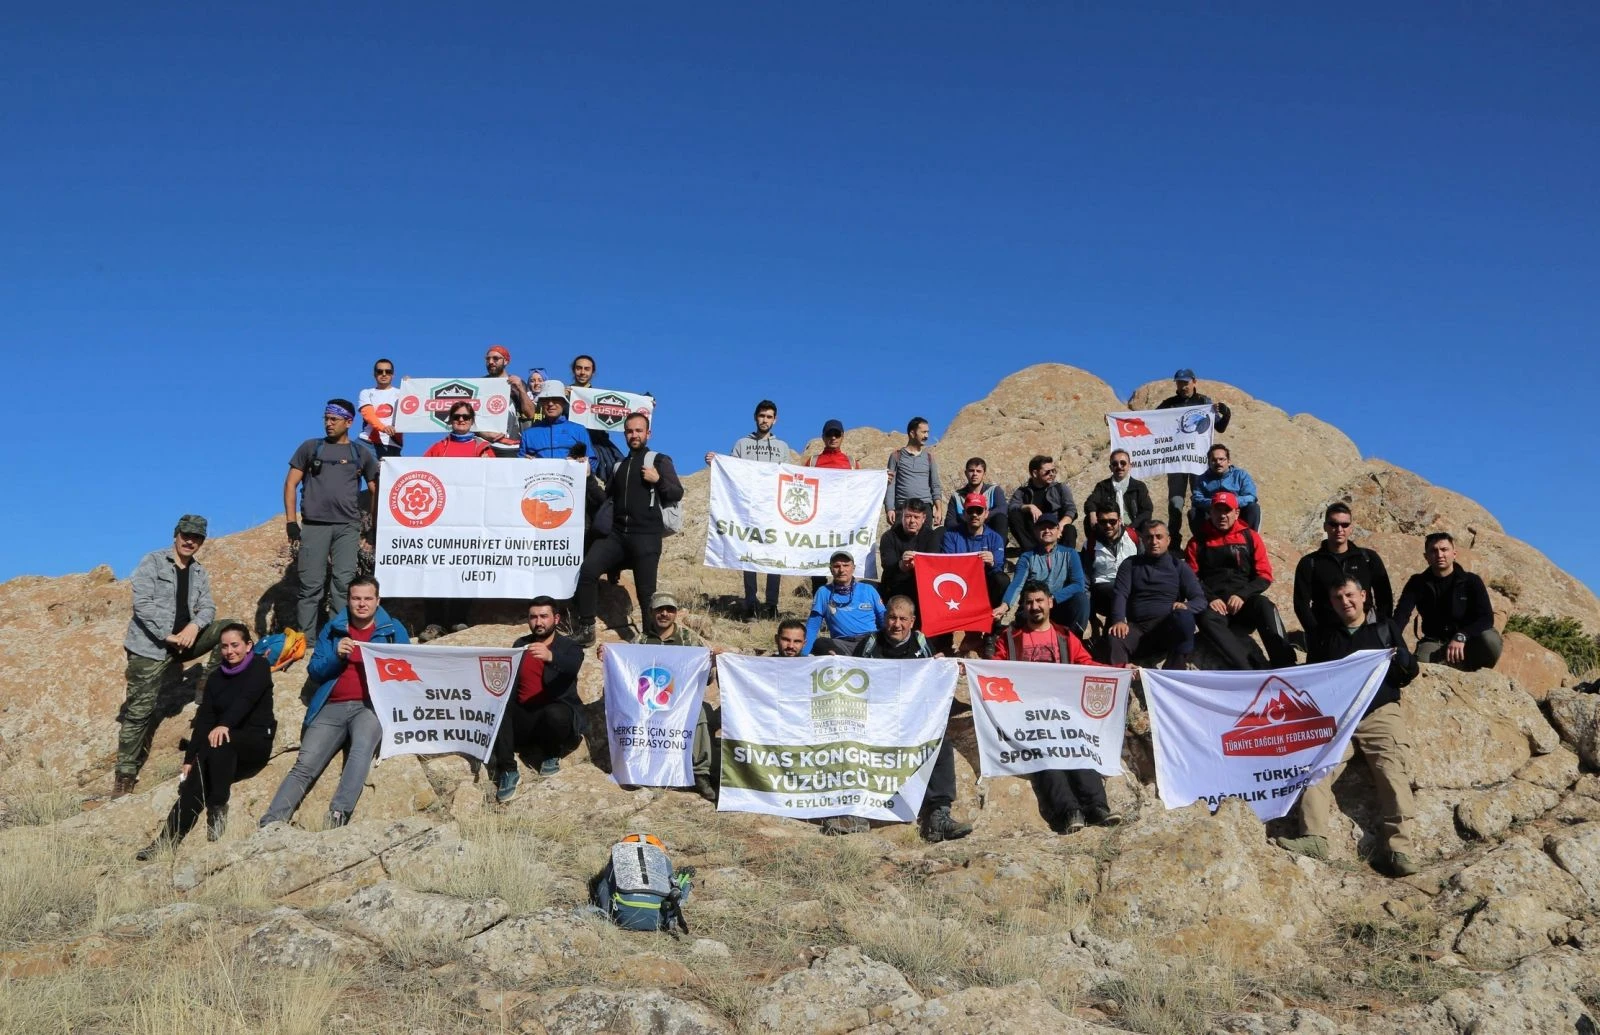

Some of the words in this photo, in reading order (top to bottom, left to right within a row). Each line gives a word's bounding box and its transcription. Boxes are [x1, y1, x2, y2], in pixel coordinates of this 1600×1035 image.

[1132, 448, 1151, 458] DOĞA
[1152, 443, 1185, 455] SPORLARI
[1186, 442, 1195, 450] VE
[1143, 455, 1180, 467] KURTARMA
[391, 535, 424, 549] SİVAS
[427, 536, 501, 550] CUMHURİYET
[505, 536, 570, 551] ÜNİVERTESİ
[379, 554, 428, 566] JEOPARK
[432, 554, 446, 565] VE
[449, 552, 513, 566] JEOTURİZM
[517, 552, 581, 566] TOPLULUĞU
[461, 570, 496, 583] (JEOT)
[392, 707, 408, 723] İL
[413, 706, 455, 721] ÖZEL
[460, 706, 495, 726] İDARE
[394, 729, 438, 745] SPOR
[613, 725, 644, 737] HERKES
[669, 728, 693, 739] SPOR
[1014, 728, 1057, 742] ÖZEL
[1061, 727, 1100, 748] İDARE
[1225, 738, 1253, 752] TÜRKİYE
[1254, 734, 1285, 747] DAĞCILIK
[1286, 727, 1333, 743] FEDERASYONU
[734, 744, 793, 768] SİVAS
[1000, 748, 1044, 764] SPOR
[768, 770, 868, 792] YÜZÜNCÜ
[873, 775, 911, 792] YIL
[785, 799, 793, 808] 4
[796, 795, 834, 809] EYLÜL
[836, 794, 861, 806] 1919
